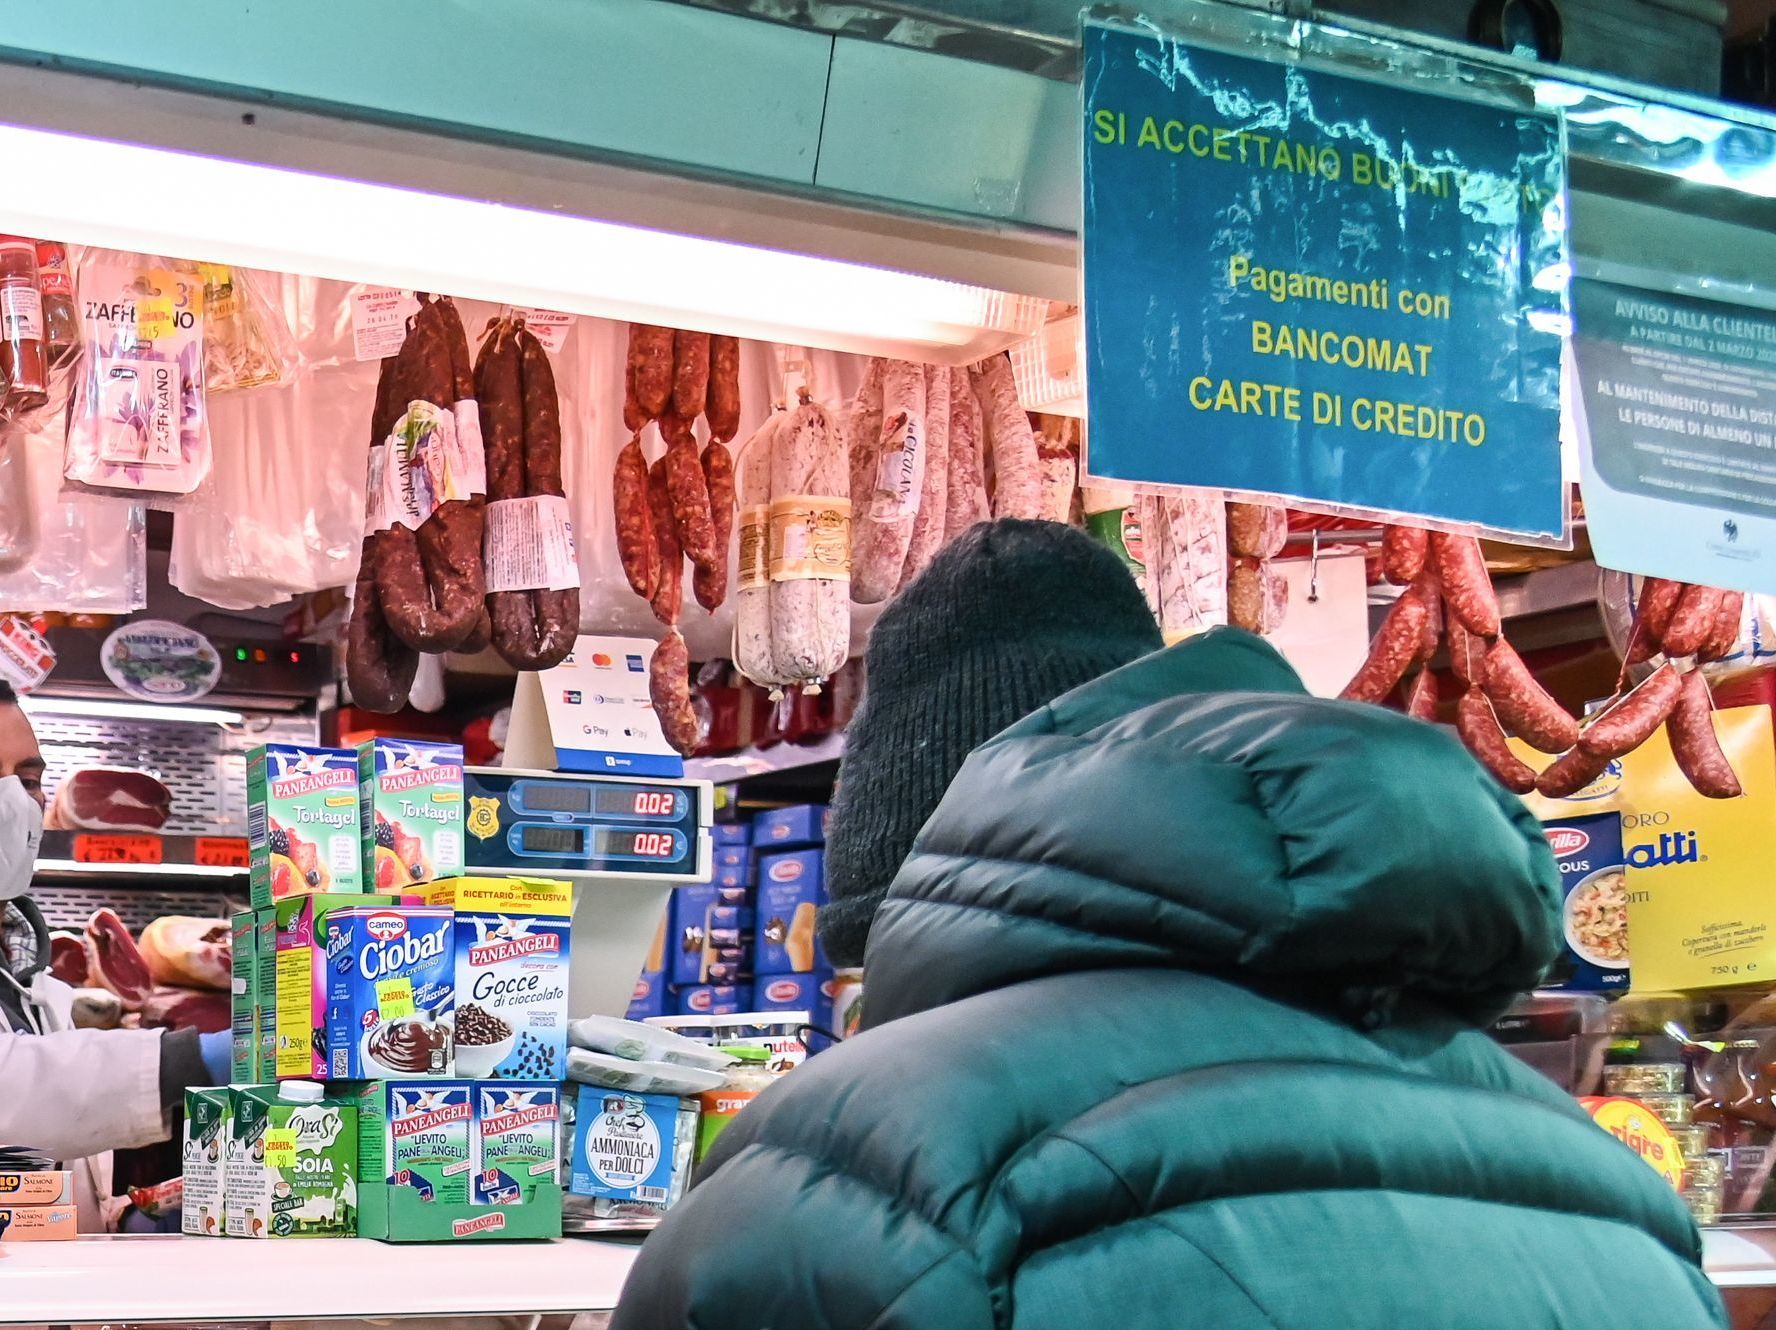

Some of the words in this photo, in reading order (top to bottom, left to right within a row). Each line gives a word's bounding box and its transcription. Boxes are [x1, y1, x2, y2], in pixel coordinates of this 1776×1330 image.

[1094, 110, 1125, 145] SI
[1137, 117, 1342, 180] ACCETTANO
[1353, 152, 1450, 198] BUONI
[1229, 256, 1389, 309] Pagamenti
[1398, 289, 1451, 319] con
[1615, 300, 1669, 325] AVVISO
[1673, 310, 1709, 333] ALLA
[1252, 320, 1433, 377] BANCOMAT
[1614, 381, 1710, 415] MANTENIMENTO
[156, 368, 169, 454] ZAFFERANO
[1188, 376, 1302, 421] CARTE
[1312, 392, 1343, 427] DI
[1351, 398, 1486, 446] CREDITO
[275, 771, 354, 799] PANEANGELI
[382, 767, 459, 792] PANEANGELI
[292, 805, 356, 829] Tortagel
[398, 799, 461, 824] Tortagel
[1623, 830, 1698, 869] atti
[463, 889, 514, 900] RICETTARIO
[522, 892, 567, 902] ESCLUSIVA
[369, 919, 404, 929] cameo
[327, 926, 354, 960] Ciobar
[360, 920, 450, 980] Ciobar
[471, 935, 558, 964] PANEANGELI
[415, 986, 451, 1006] Classico
[473, 972, 539, 1000] Gocce
[493, 993, 505, 1007] di
[508, 986, 564, 1006] cioccolato
[394, 1106, 470, 1136] PANEANGELI
[482, 1106, 557, 1136] PANEANGELI
[398, 1146, 421, 1159] PANE
[486, 1145, 509, 1158] PANE
[590, 1137, 654, 1160] AMMONIACA
[292, 1157, 334, 1173] SOIA
[394, 1170, 410, 1184] 10
[482, 1169, 498, 1183] 10
[598, 1158, 614, 1170] PER
[614, 1157, 644, 1175] DOLCI
[23, 1177, 54, 1187] SALMONE
[15, 1211, 44, 1221] SALMONE
[455, 1213, 504, 1236] PANEANGELI
